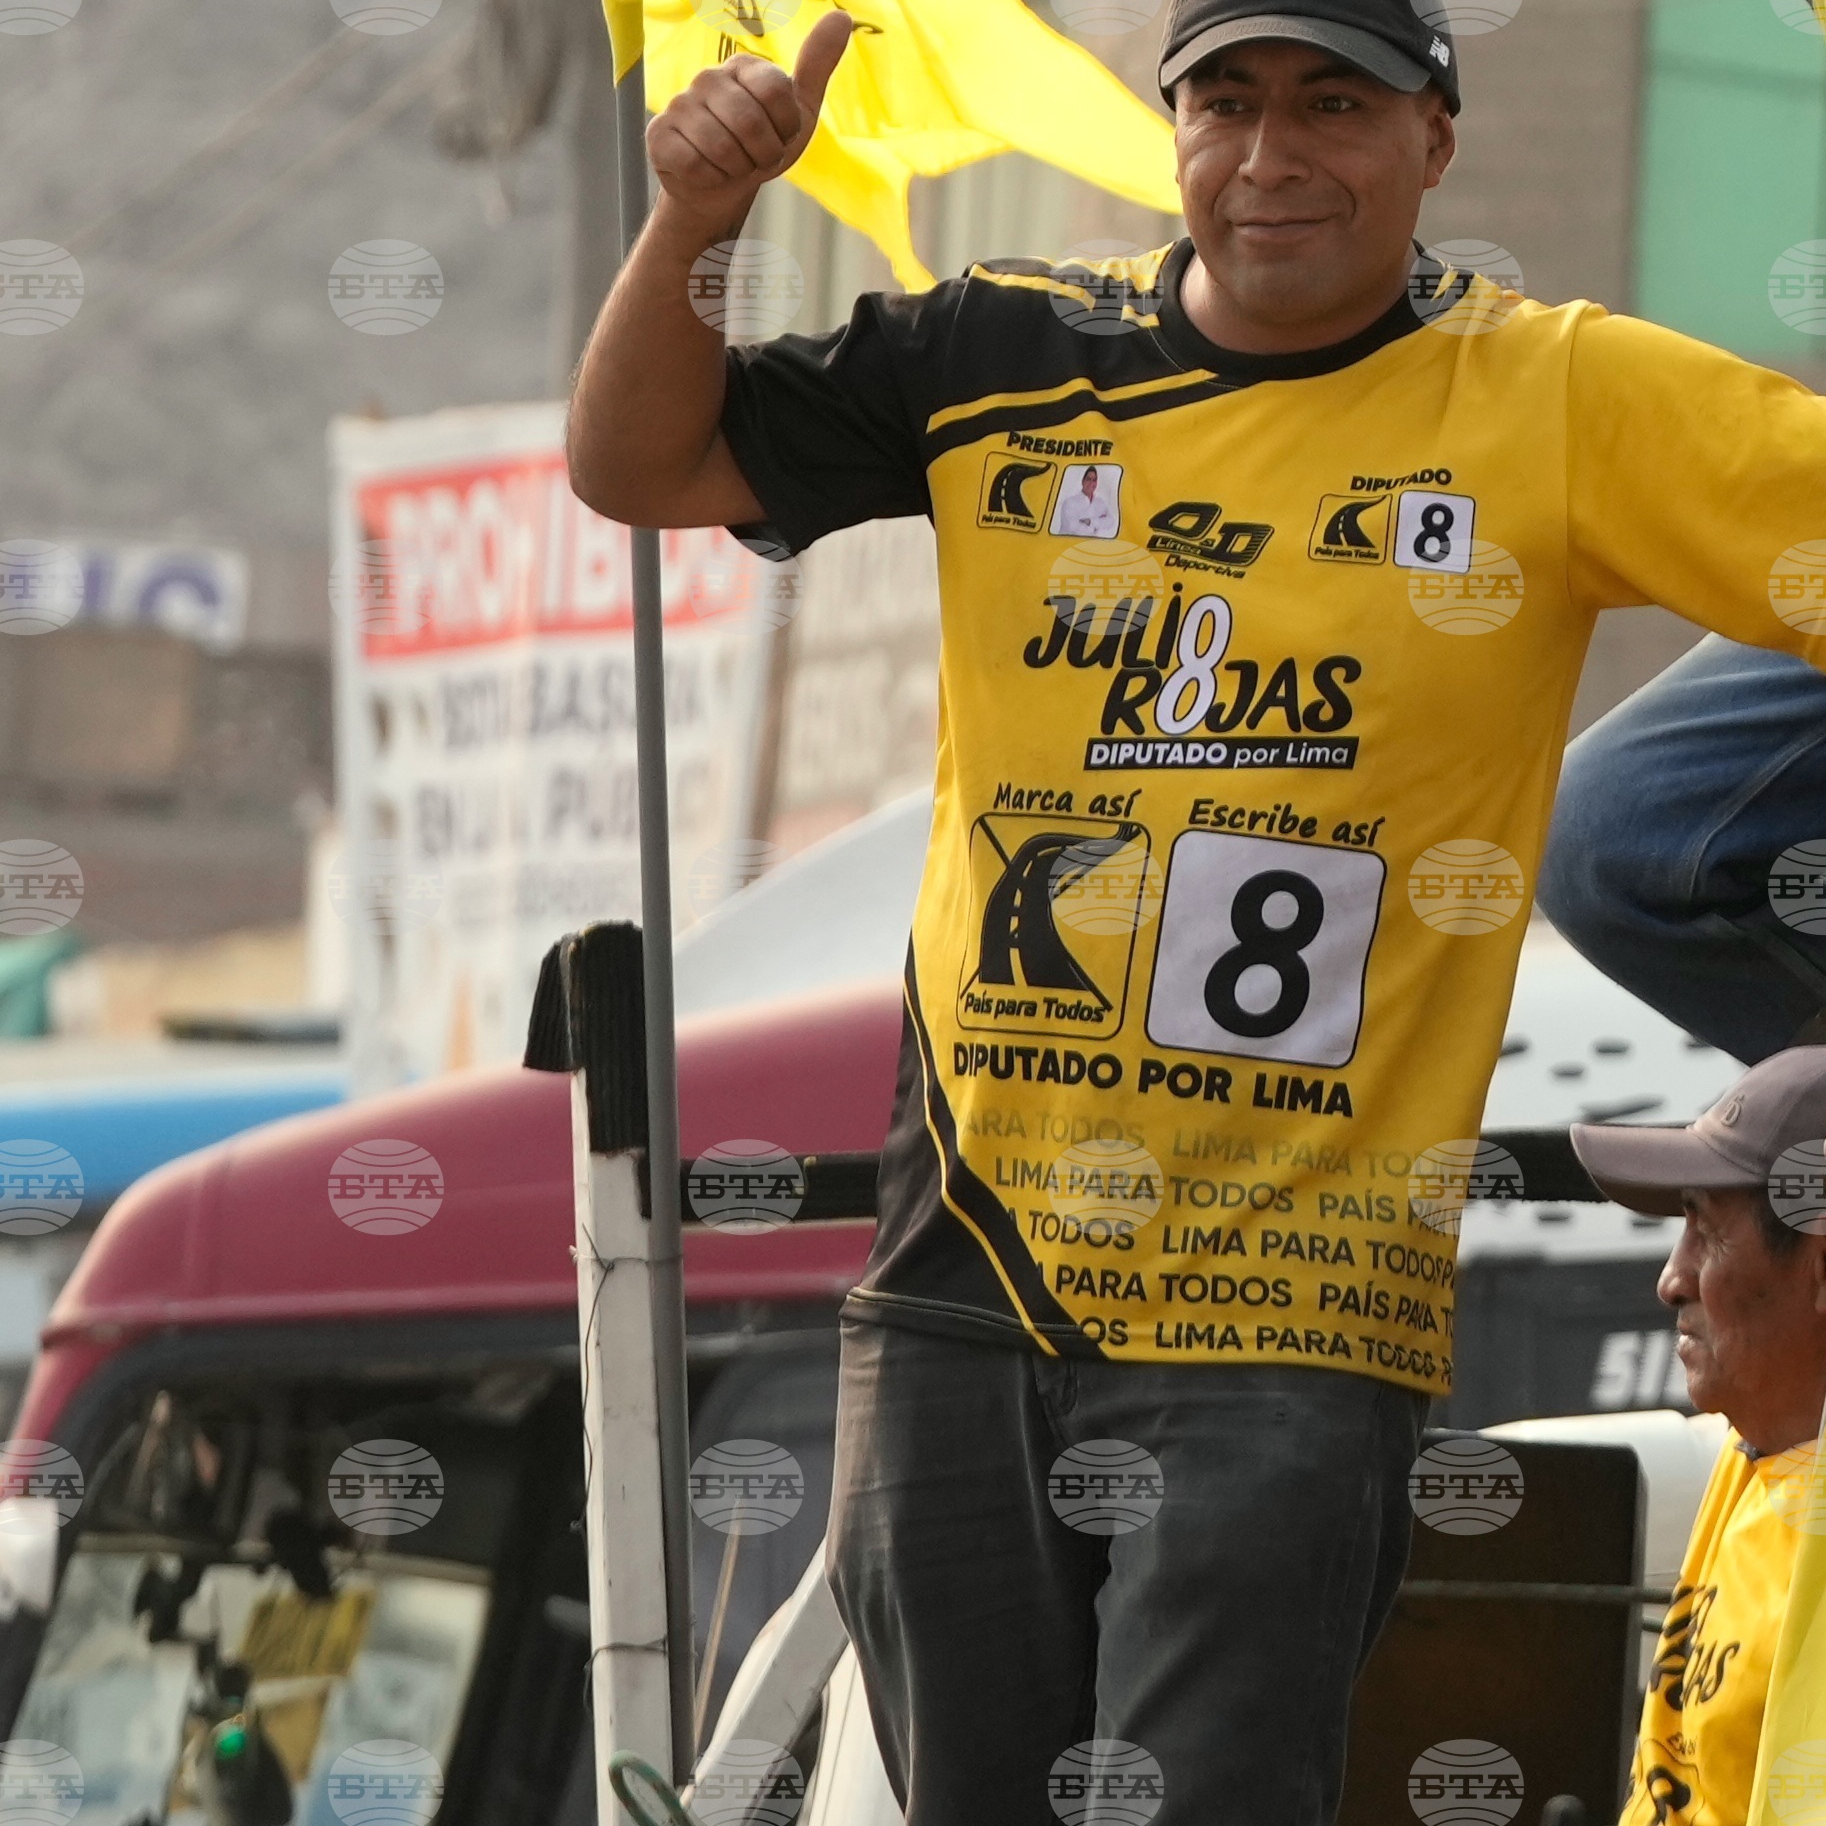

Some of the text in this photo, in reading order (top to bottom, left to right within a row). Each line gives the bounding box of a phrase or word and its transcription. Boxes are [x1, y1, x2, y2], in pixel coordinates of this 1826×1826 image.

[1006, 430, 1114, 457] PRESIDENTE
[1350, 468, 1452, 492] DIPUTADO
[1413, 502, 1454, 564] 8
[1164, 553, 1247, 580] Deportiva
[1089, 741, 1349, 769] DIPUTADO por Lima
[993, 781, 1386, 848] Marca así Escribe así
[1203, 869, 1325, 1038] 8
[964, 989, 1105, 1023] País para Todos
[953, 1042, 1354, 1119] DIPUTADO POR LIMA
[995, 1156, 1058, 1193] LIMA
[1068, 1164, 1157, 1203] PARA
[1169, 1174, 1295, 1214] TODOS
[1318, 1187, 1397, 1224] PAÍS
[1028, 1209, 1136, 1252] TODOS
[1161, 1224, 1248, 1258] LIMA
[1260, 1228, 1356, 1267] PARA
[1055, 1263, 1148, 1303] PARA
[1158, 1272, 1293, 1308] TODOS
[1318, 1279, 1391, 1321] PAÍS
[1155, 1320, 1243, 1351] LIMA
[1256, 1324, 1353, 1361] PARA
